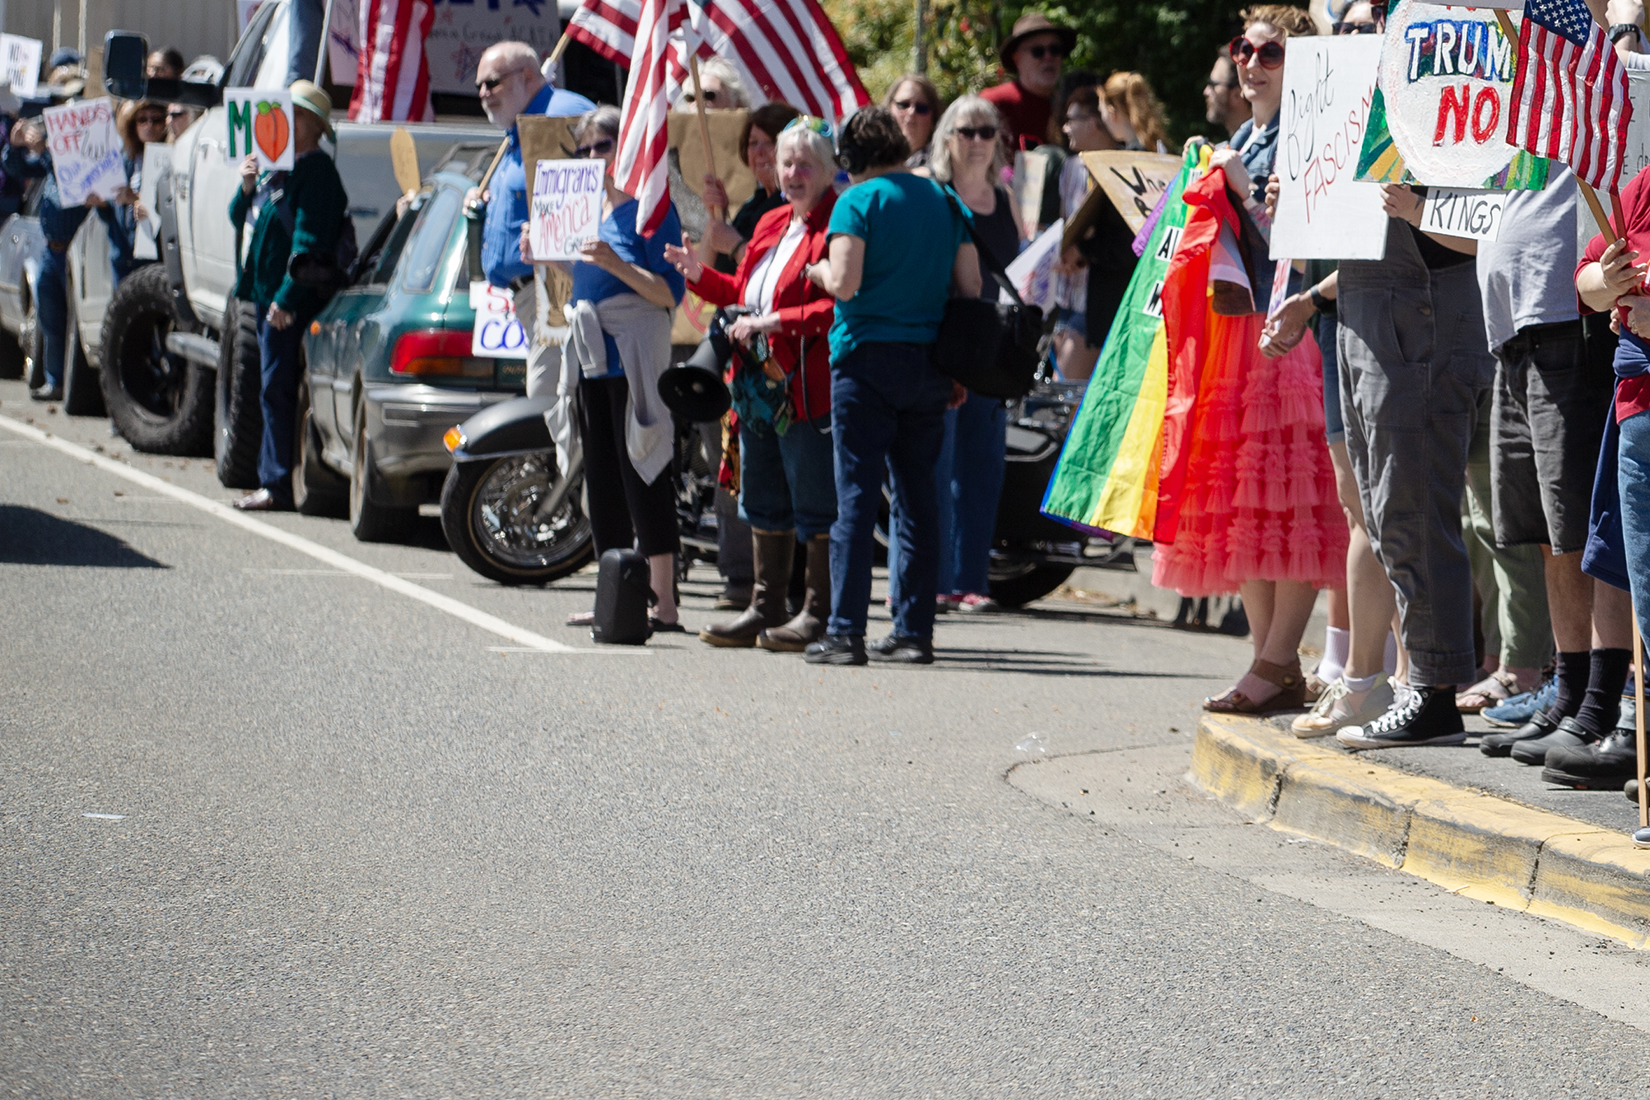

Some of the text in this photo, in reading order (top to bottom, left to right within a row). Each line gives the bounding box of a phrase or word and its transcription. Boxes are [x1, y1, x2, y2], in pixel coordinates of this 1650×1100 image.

[1406, 22, 1511, 81] TRUM
[47, 104, 111, 133] HANDS
[229, 100, 251, 158] M
[1433, 83, 1500, 146] NO
[53, 133, 82, 155] OFF
[533, 163, 599, 210] Immigrants
[1430, 190, 1501, 234] KINGS
[480, 319, 529, 350] CO
